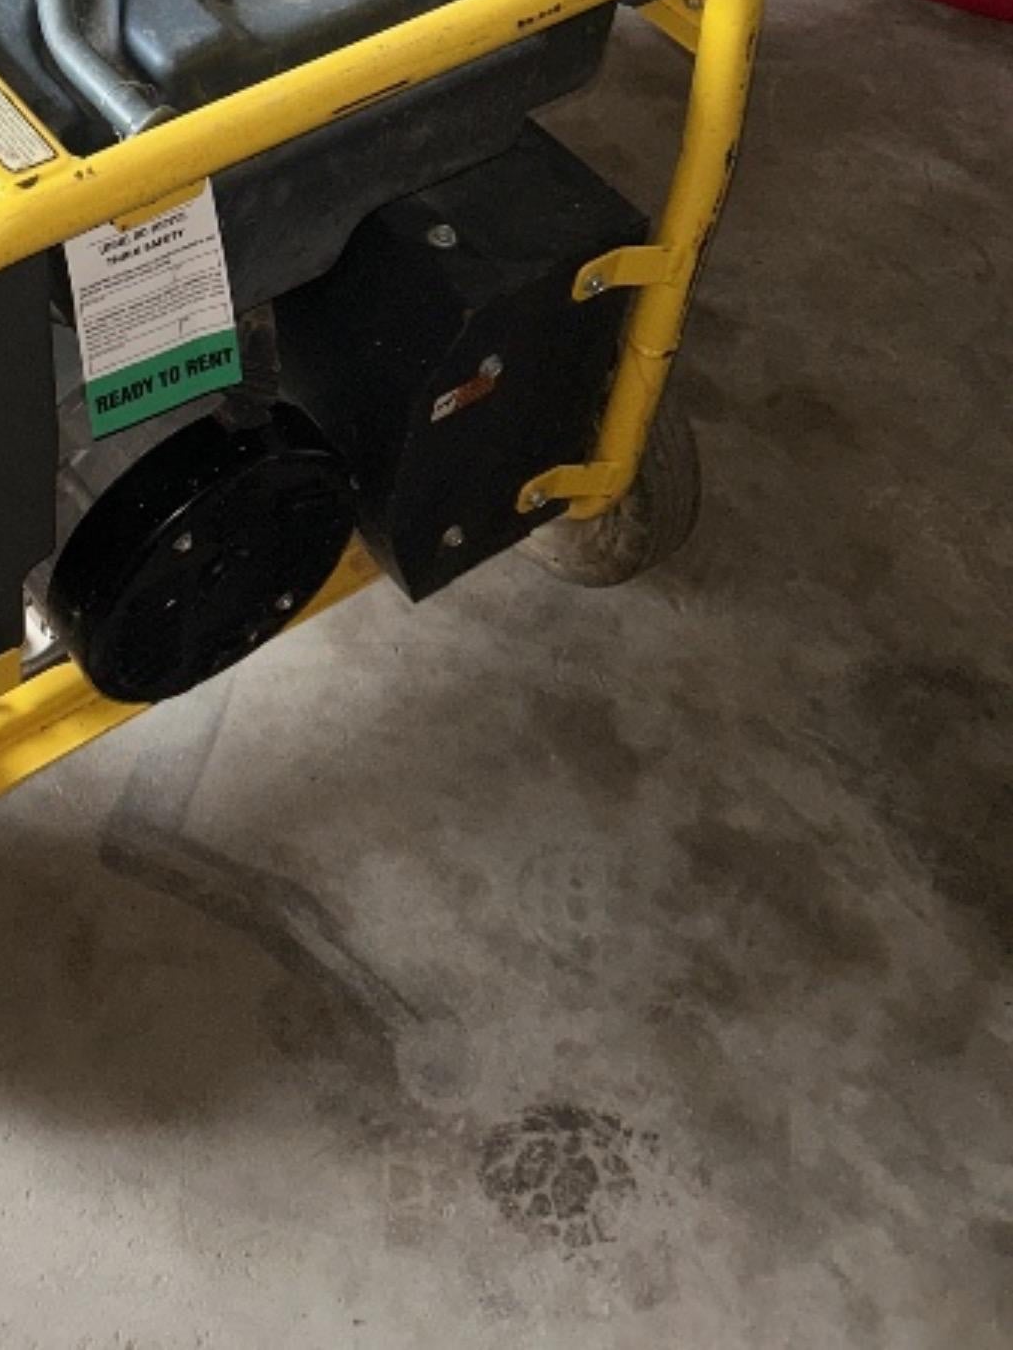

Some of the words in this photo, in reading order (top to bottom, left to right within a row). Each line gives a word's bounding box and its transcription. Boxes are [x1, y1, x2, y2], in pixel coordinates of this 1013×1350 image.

[94, 375, 155, 415] READY
[157, 364, 182, 390] TO
[184, 346, 235, 379] RENT
